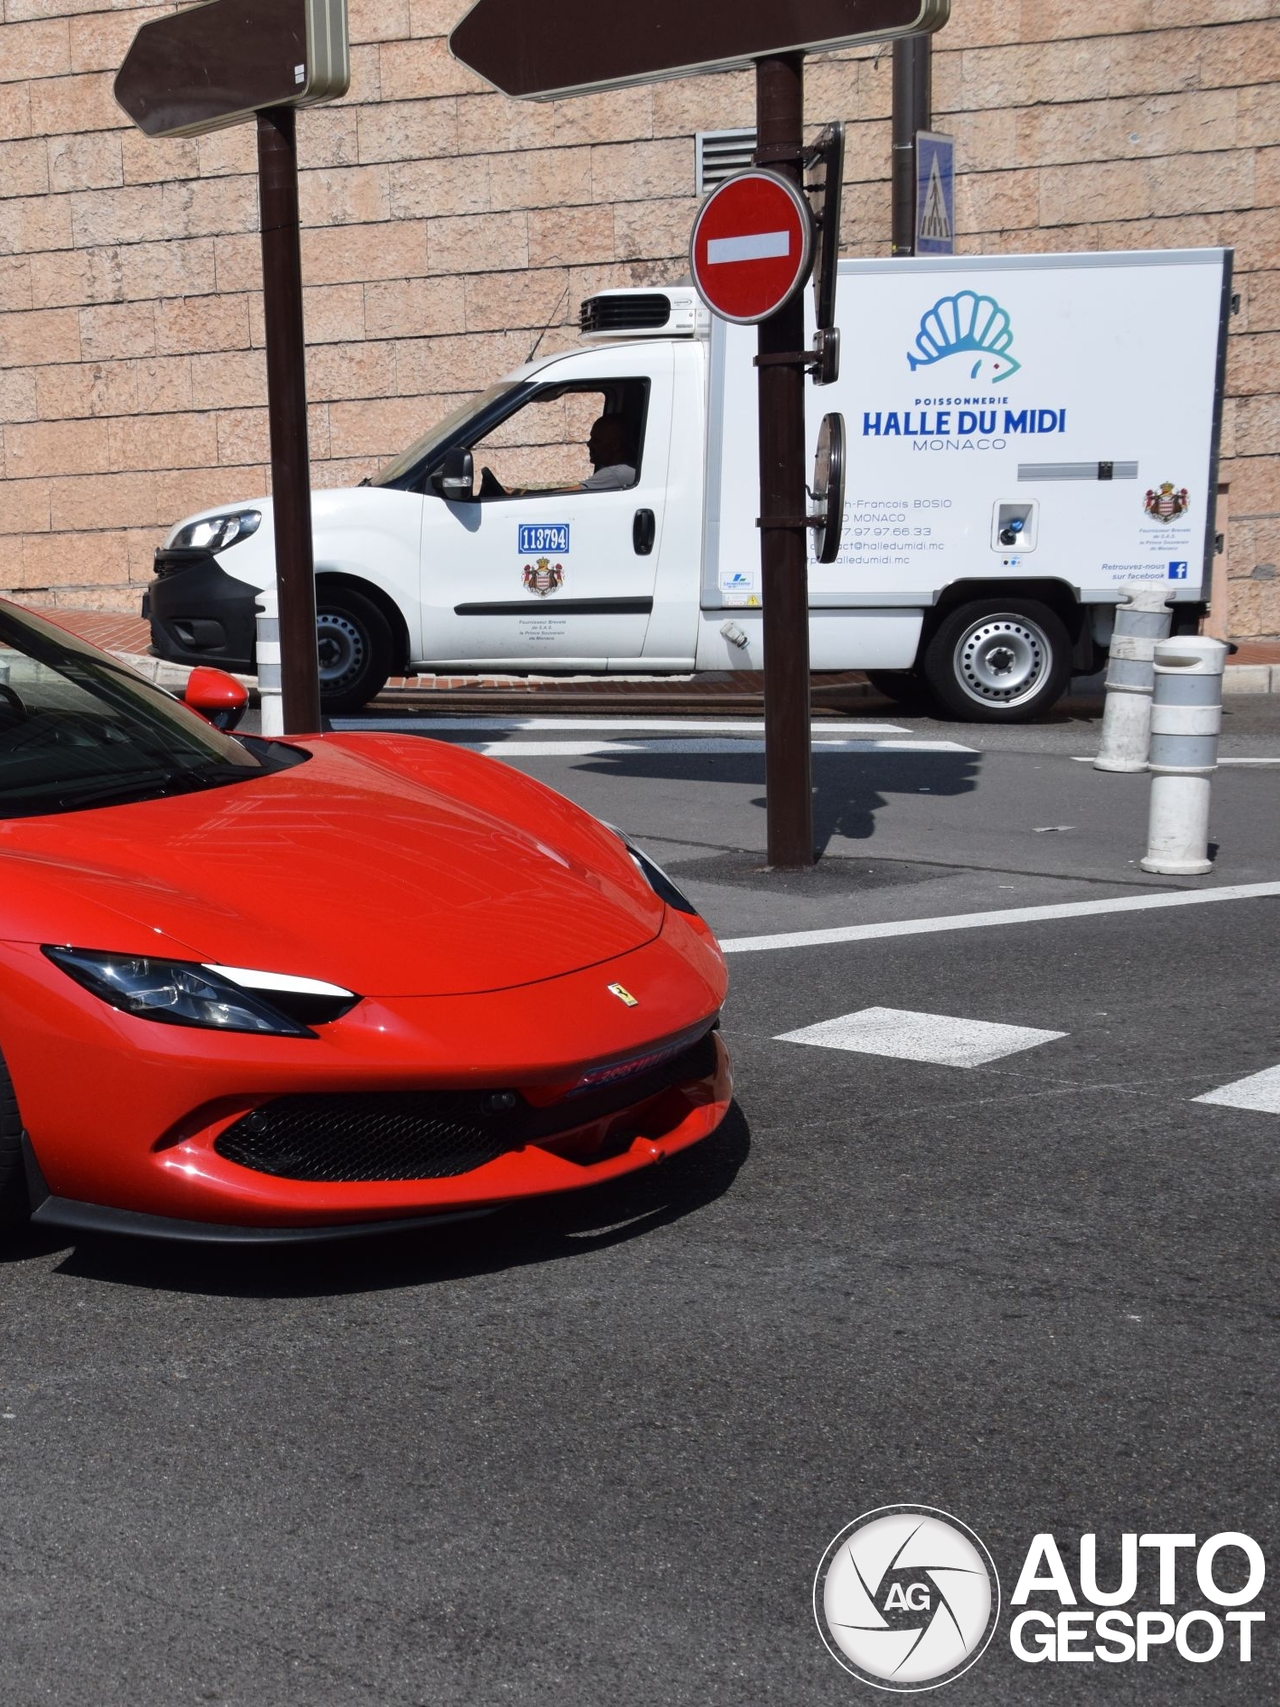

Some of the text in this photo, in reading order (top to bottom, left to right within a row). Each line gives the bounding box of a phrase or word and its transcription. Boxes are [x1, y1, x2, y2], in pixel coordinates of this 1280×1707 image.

[914, 397, 1009, 406] POISSONNERIE
[862, 408, 1066, 436] HALLE DU MIDI
[912, 438, 1007, 451] MONACO
[809, 499, 952, 509] h-Francois BOSIO
[853, 514, 906, 523] MONACO
[523, 528, 566, 550] 113794
[1101, 563, 1166, 571] Retrouvez-nous
[1128, 572, 1166, 580] facebook
